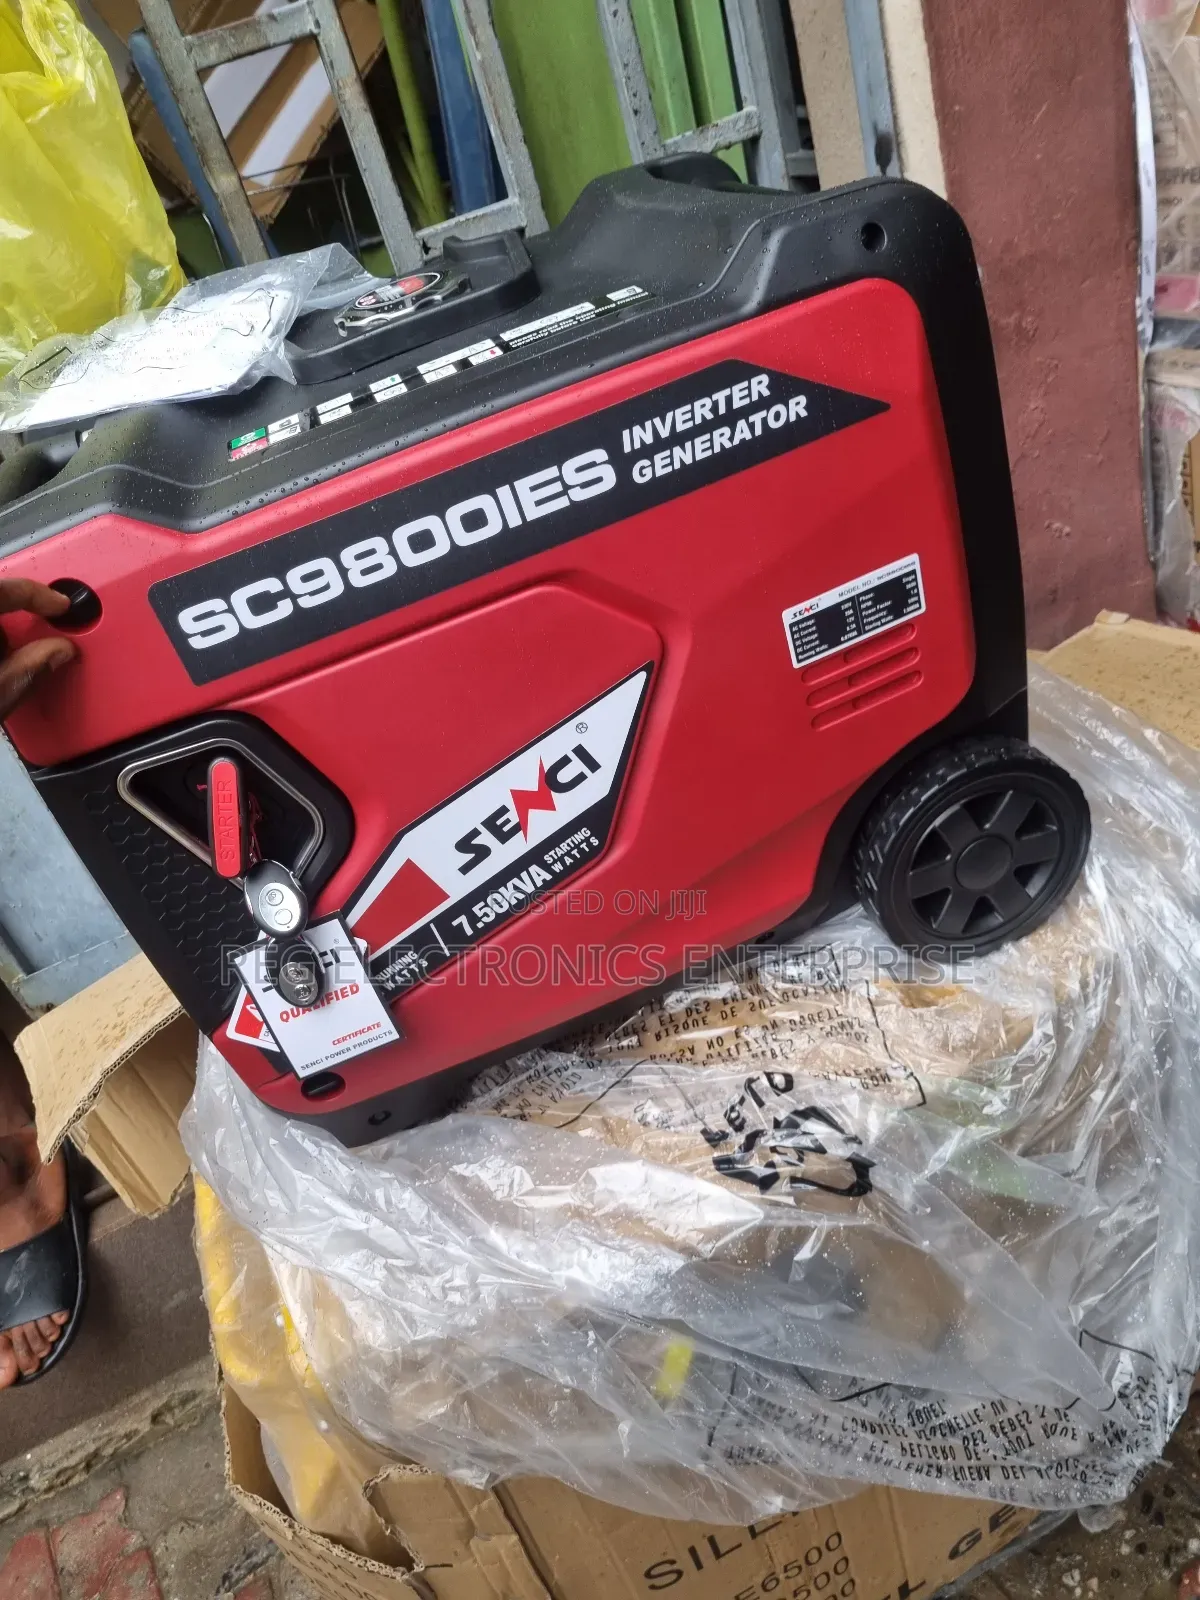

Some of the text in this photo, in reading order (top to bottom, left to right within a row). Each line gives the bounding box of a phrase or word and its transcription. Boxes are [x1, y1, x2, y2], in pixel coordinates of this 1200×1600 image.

[622, 373, 771, 454] INVERTER
[632, 394, 808, 484] GENERATOR
[177, 448, 618, 650] SC9800IES
[791, 603, 819, 620] SENCI
[838, 585, 861, 597] MODEL
[216, 780, 235, 860] STARTER
[454, 742, 602, 877] SENCI
[543, 826, 592, 865] STARTING
[551, 836, 600, 874] WATTS
[452, 864, 553, 937] 7.50KVA
[376, 950, 418, 982] RUNNING
[383, 958, 429, 992] WATTS
[300, 1029, 393, 1071] SENCI POWER PRODUCTS
[332, 1021, 383, 1046] CERTIFICATE
[644, 1510, 800, 1591] SIL
[949, 1503, 1024, 1560] GE
